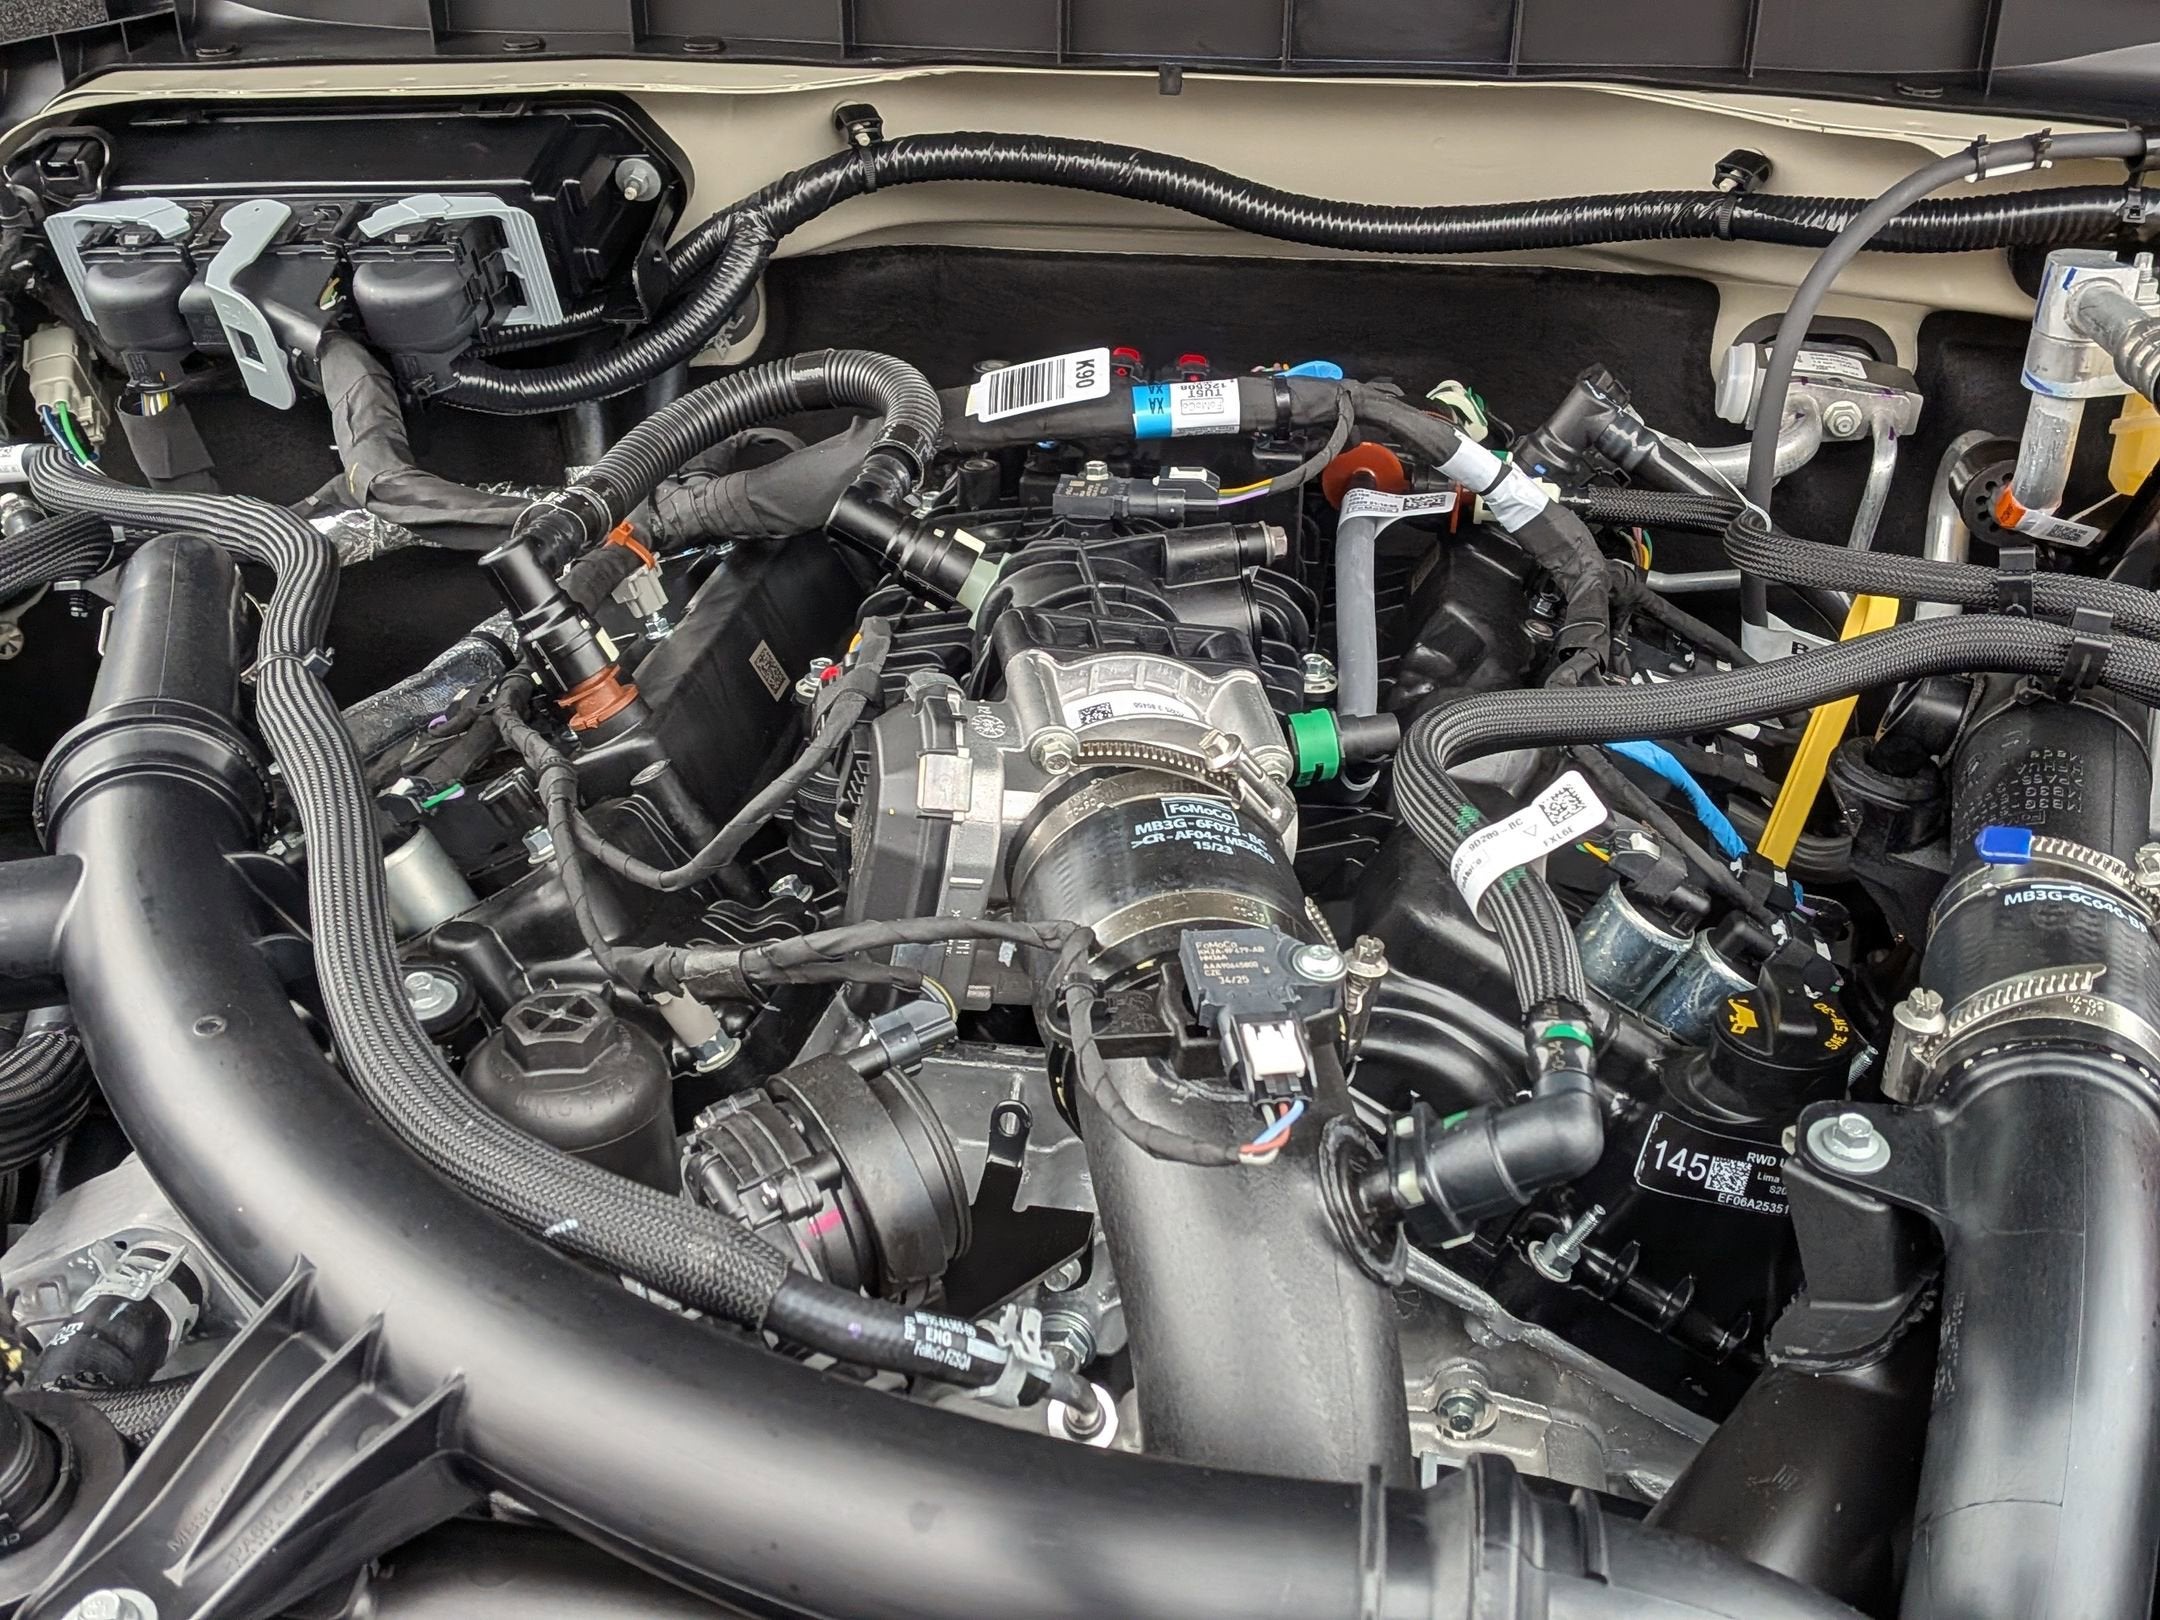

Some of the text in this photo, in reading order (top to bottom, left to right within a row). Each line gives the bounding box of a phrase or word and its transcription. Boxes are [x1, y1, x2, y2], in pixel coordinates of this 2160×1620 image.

[1076, 358, 1095, 388] K90
[1149, 398, 1164, 414] XA
[1169, 803, 1232, 822] FoMoCo
[1193, 841, 1233, 855] 15/23
[1224, 836, 1276, 865] MEXICO
[1196, 940, 1238, 949] FoMoCo
[1823, 1033, 1849, 1051] SAE
[1654, 1139, 1710, 1181] 145
[1746, 1151, 1777, 1167] RWD
[1757, 1172, 1780, 1183] Lima
